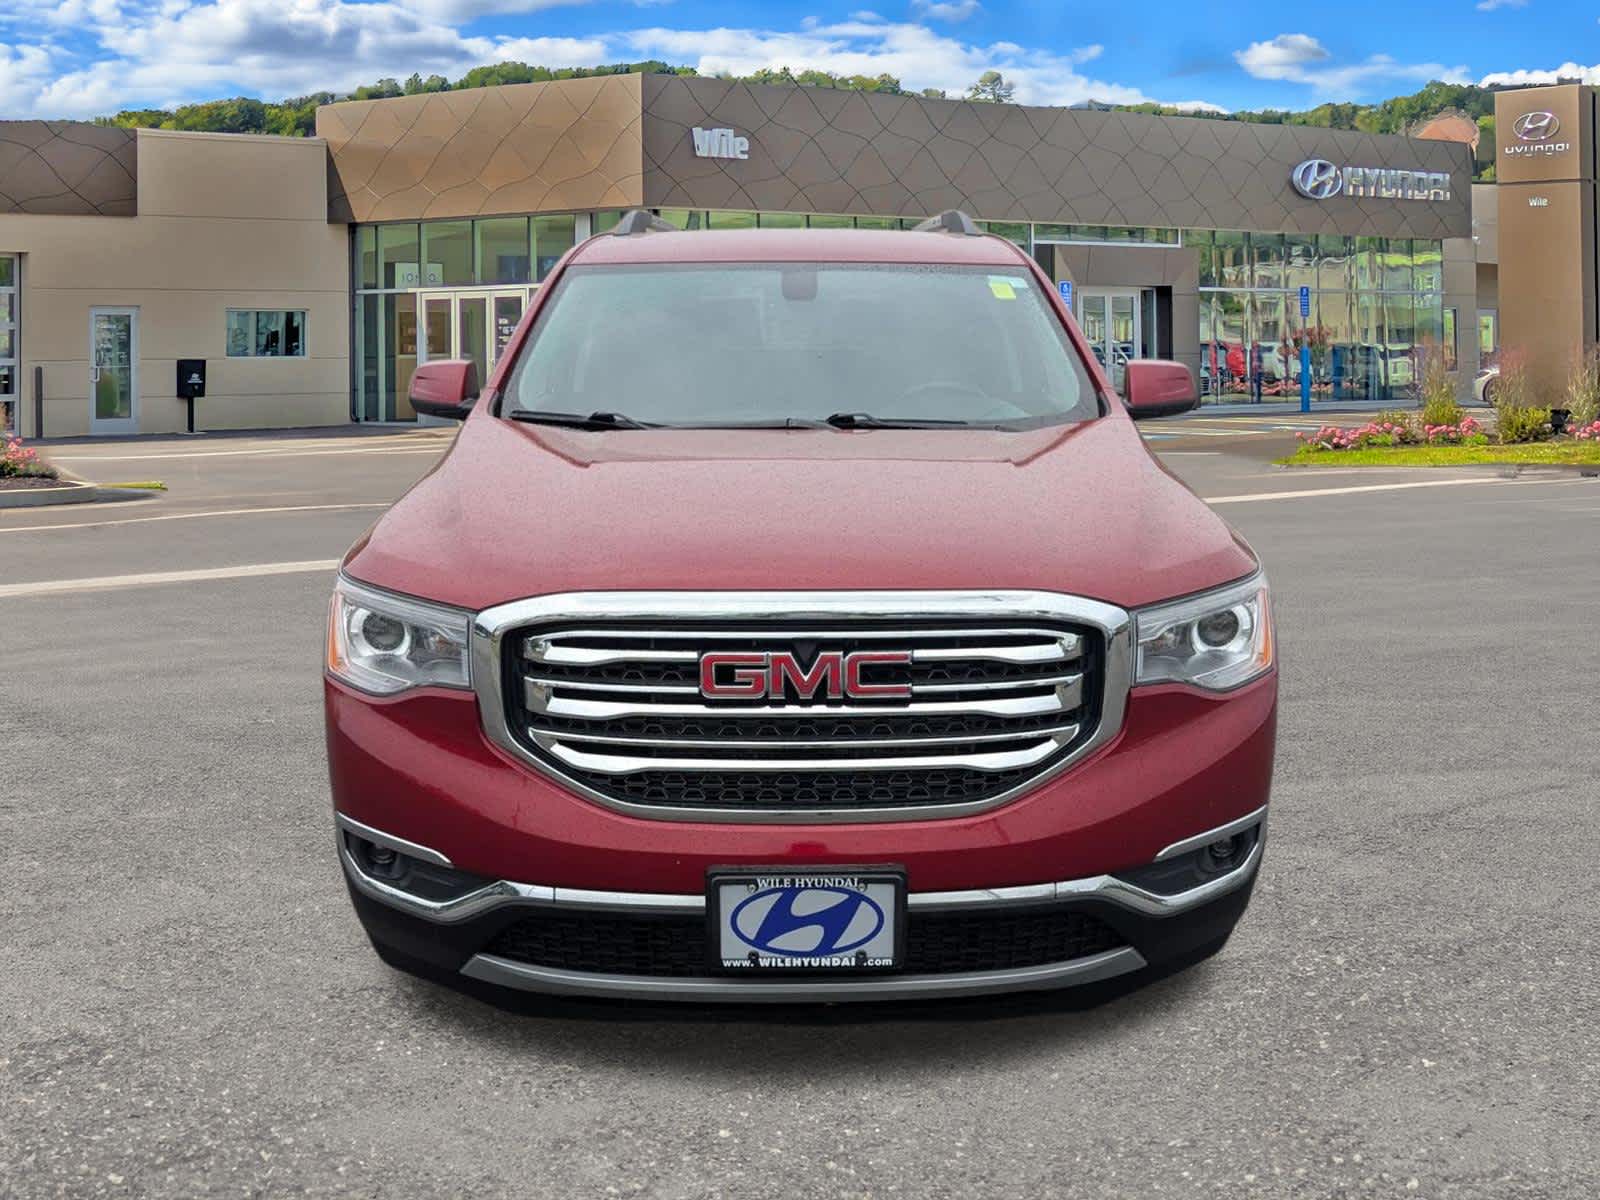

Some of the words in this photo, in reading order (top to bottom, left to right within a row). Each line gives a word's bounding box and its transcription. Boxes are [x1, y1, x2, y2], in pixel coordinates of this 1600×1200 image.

[692, 127, 749, 159] Wile
[1342, 167, 1450, 200] HYUNDAI
[1528, 197, 1549, 206] Wile
[700, 651, 912, 699] GMC
[757, 877, 791, 888] WILE
[795, 877, 859, 888] HYUNDAI
[758, 956, 856, 967] WILEHYUNDAI
